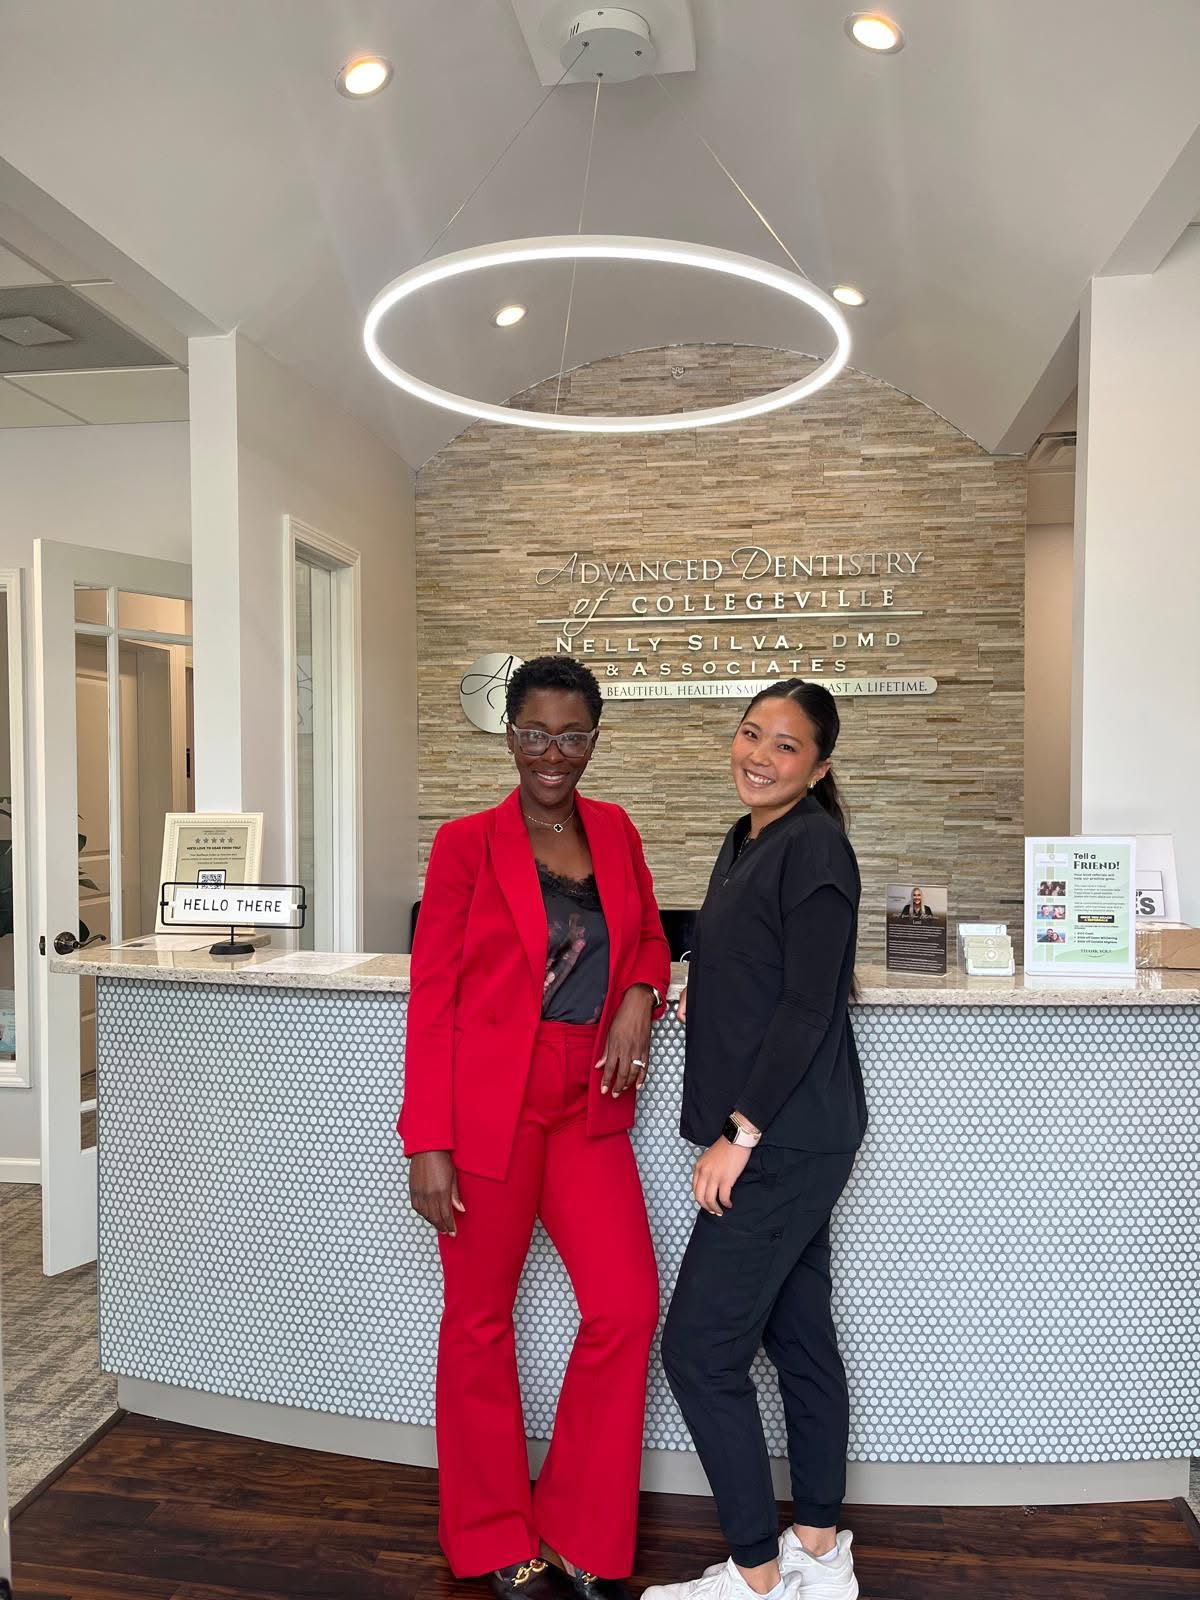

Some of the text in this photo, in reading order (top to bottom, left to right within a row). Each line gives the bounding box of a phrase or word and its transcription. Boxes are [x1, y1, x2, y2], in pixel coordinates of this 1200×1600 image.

[563, 587, 894, 637] of COLLEGEVILLE
[556, 632, 901, 653] NELLY SILVA, DMD
[606, 659, 847, 676] & ASSOCIATES
[677, 685, 732, 696] HEALTHY
[854, 682, 863, 692] A
[867, 681, 928, 692] LIFETIME.
[1073, 852, 1089, 860] Tell
[1073, 860, 1120, 870] FRIEND!
[183, 899, 282, 913] HELLO THERE
